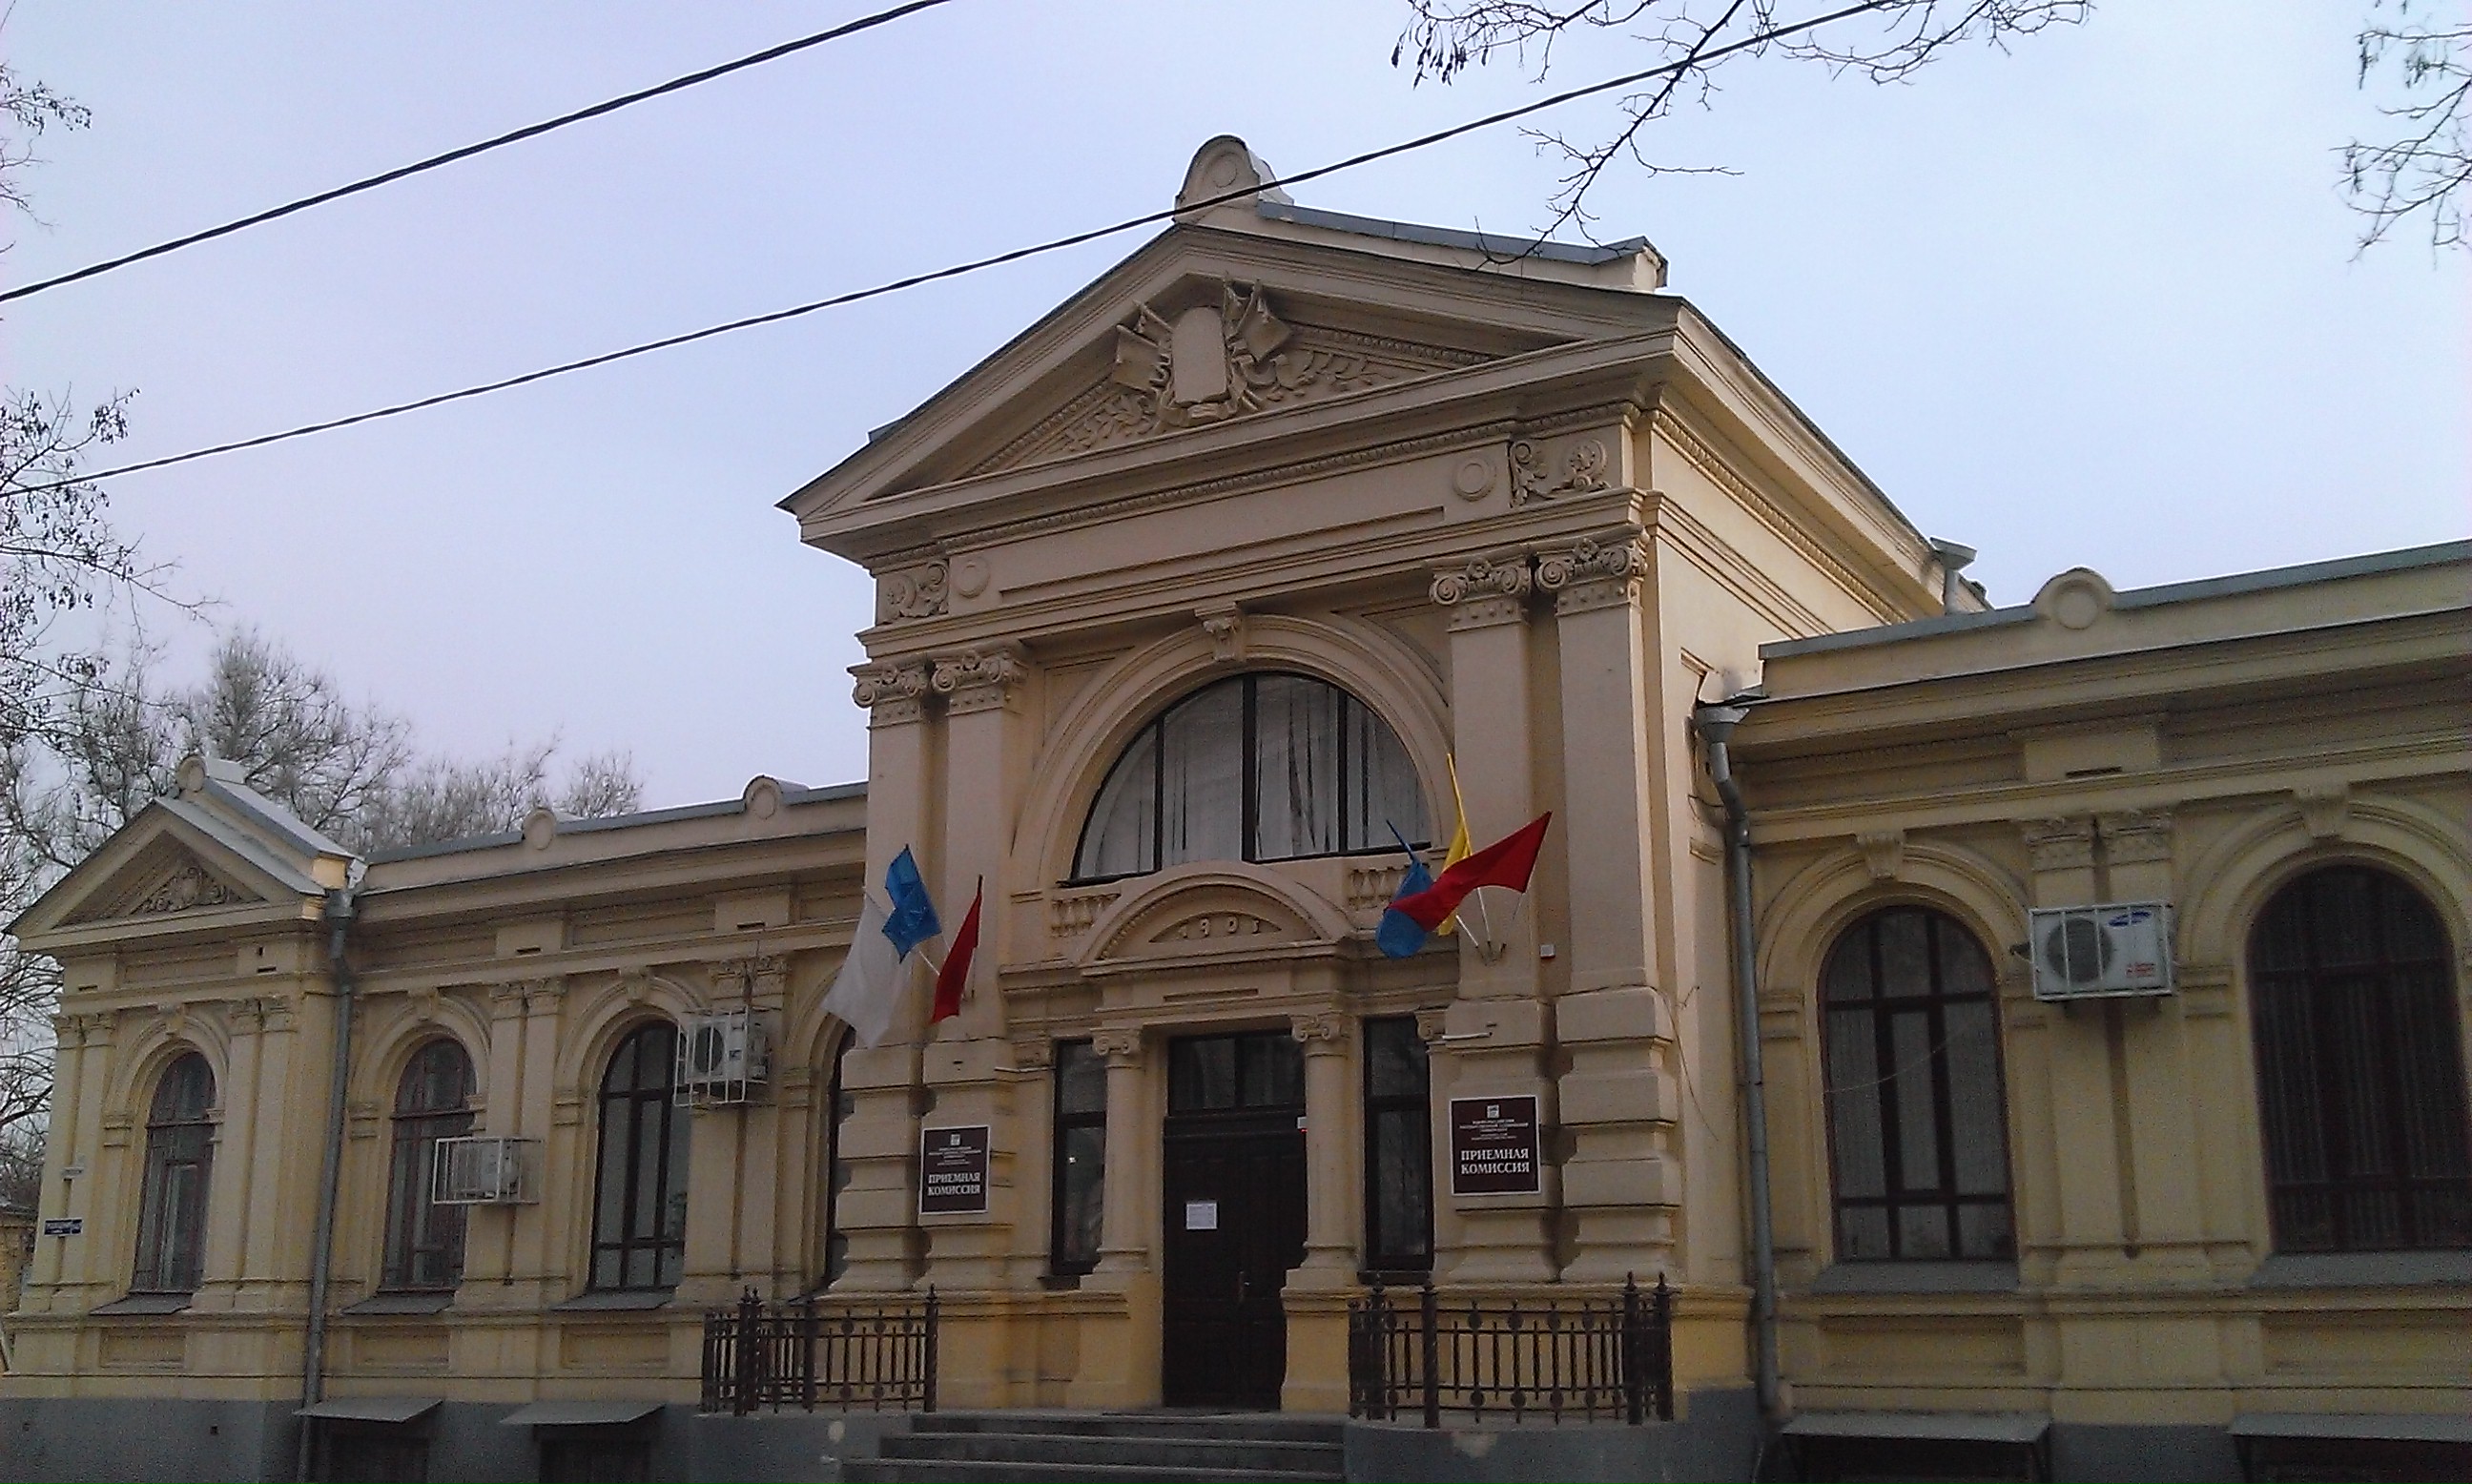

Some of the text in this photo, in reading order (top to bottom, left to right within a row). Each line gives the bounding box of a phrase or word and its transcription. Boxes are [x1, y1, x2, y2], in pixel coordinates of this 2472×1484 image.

[1461, 1148, 1529, 1161] ПРИЕМНАЯ
[1461, 1162, 1530, 1174] КОМИССИЯ
[928, 1172, 980, 1184] ПРИЕМНАЯ
[927, 1185, 980, 1196] КОМИССИЯ
